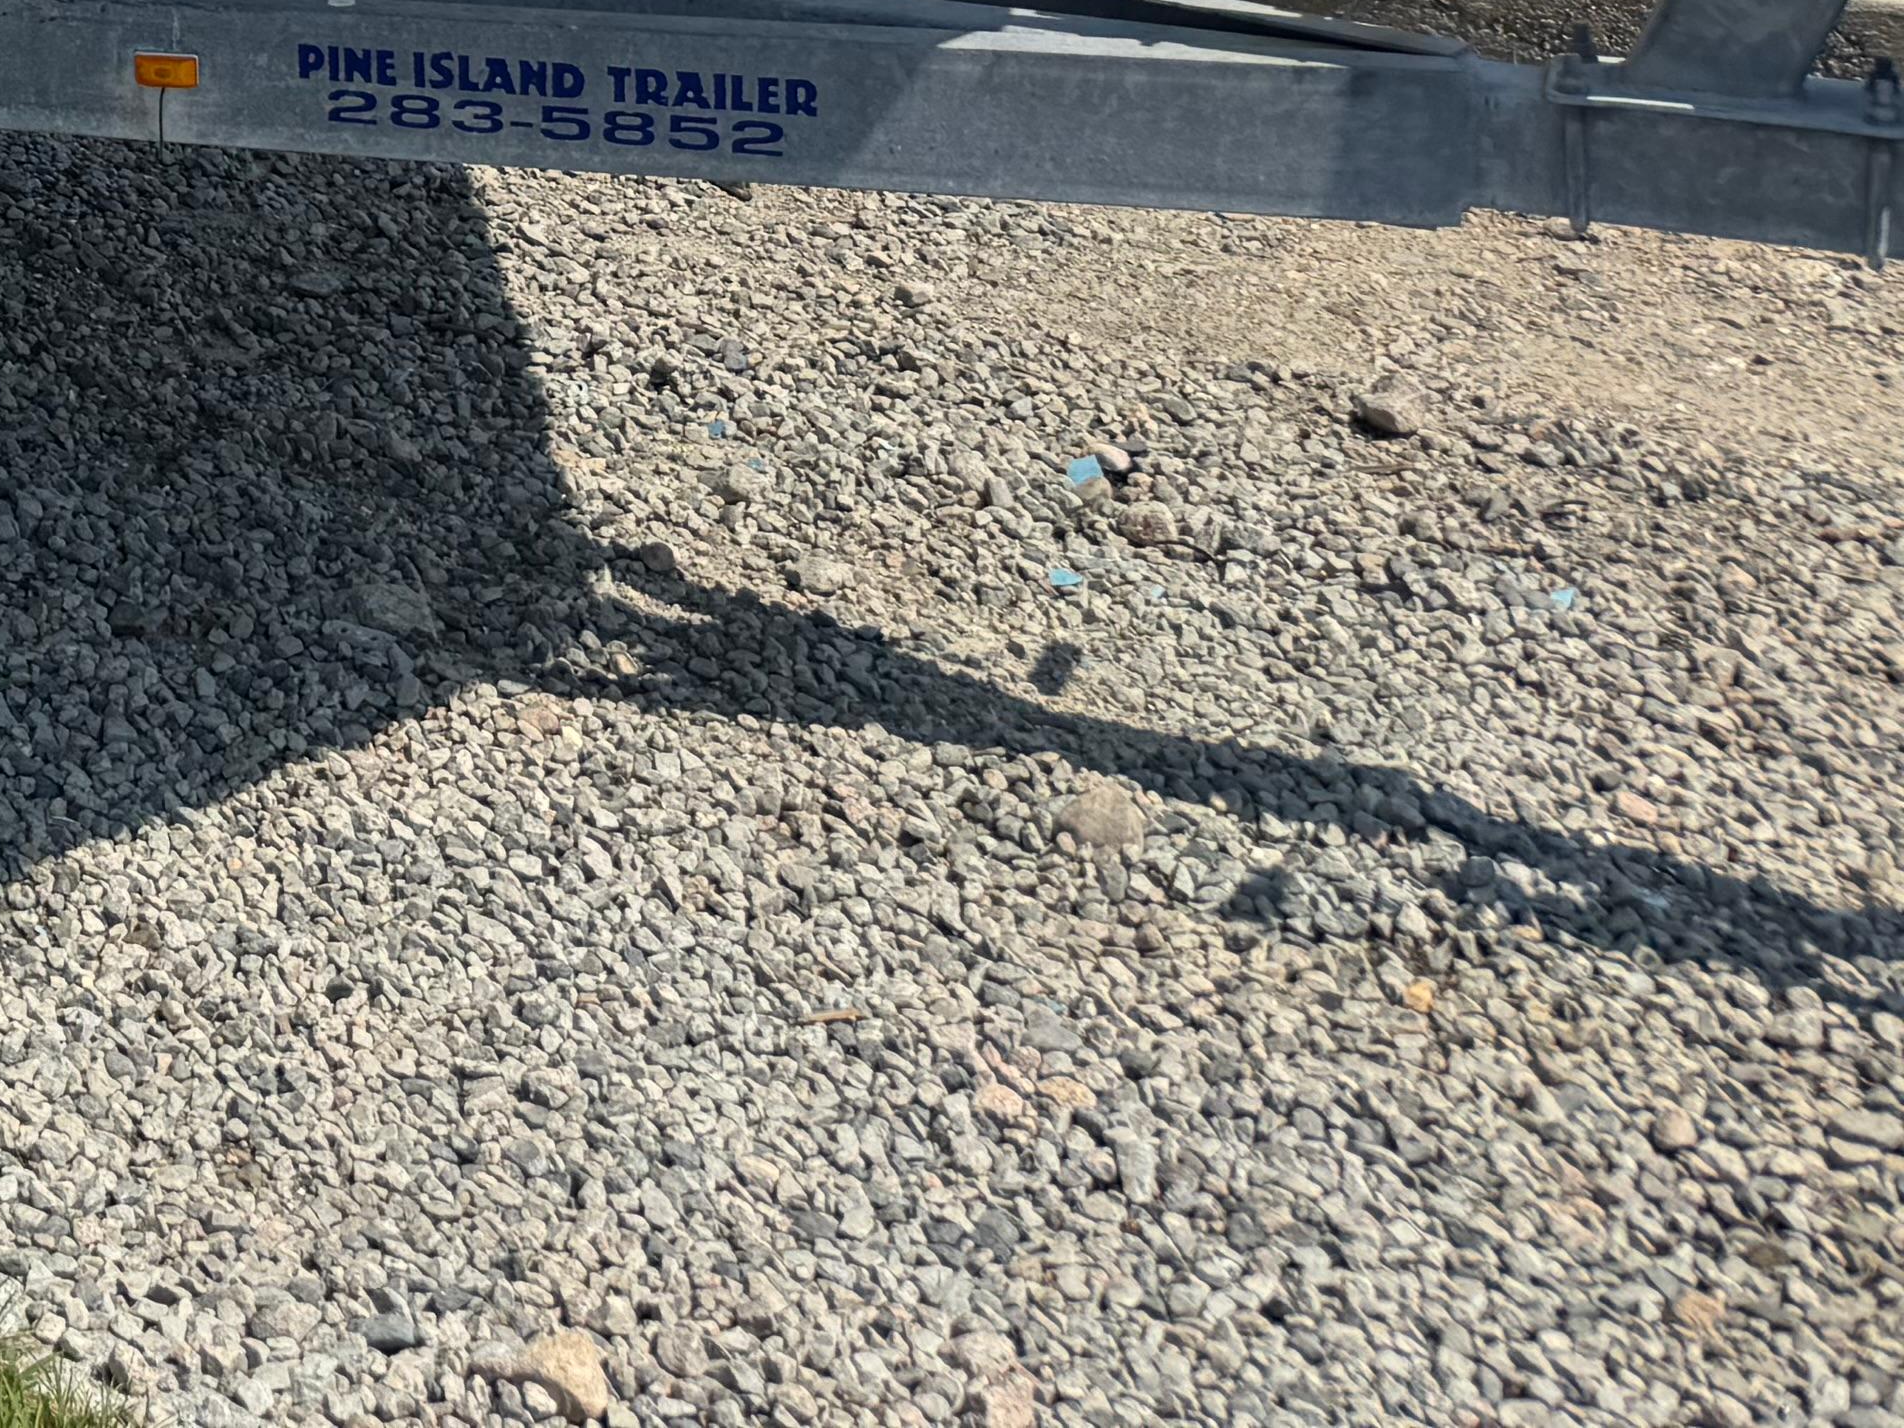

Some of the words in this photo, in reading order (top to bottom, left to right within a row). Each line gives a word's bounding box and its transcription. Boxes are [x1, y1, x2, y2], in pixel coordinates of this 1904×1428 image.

[298, 43, 397, 87] PINE
[413, 50, 586, 101] ISLAND
[607, 64, 819, 118] TRAILER
[327, 89, 785, 157] 283-5852
